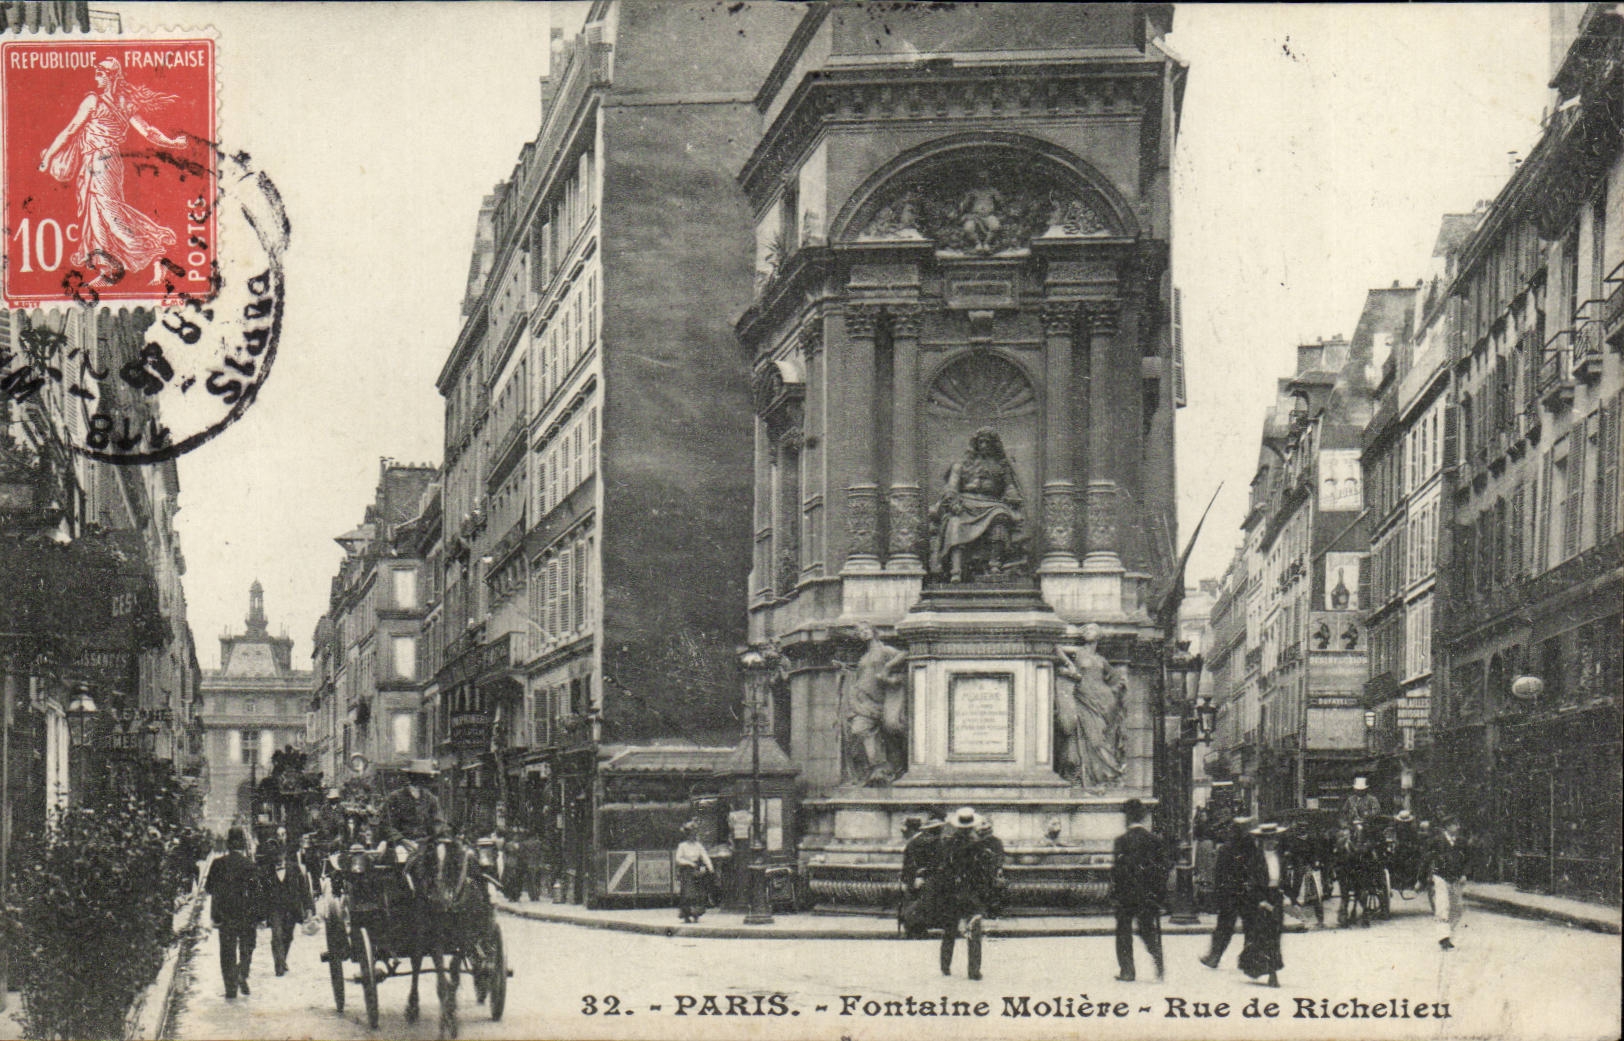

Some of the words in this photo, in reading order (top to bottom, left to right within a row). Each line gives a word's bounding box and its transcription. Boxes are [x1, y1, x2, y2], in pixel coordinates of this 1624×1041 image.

[11, 51, 97, 71] REPUBLIQUE
[124, 50, 206, 69] FRANÇAISE
[187, 198, 207, 282] POSTES
